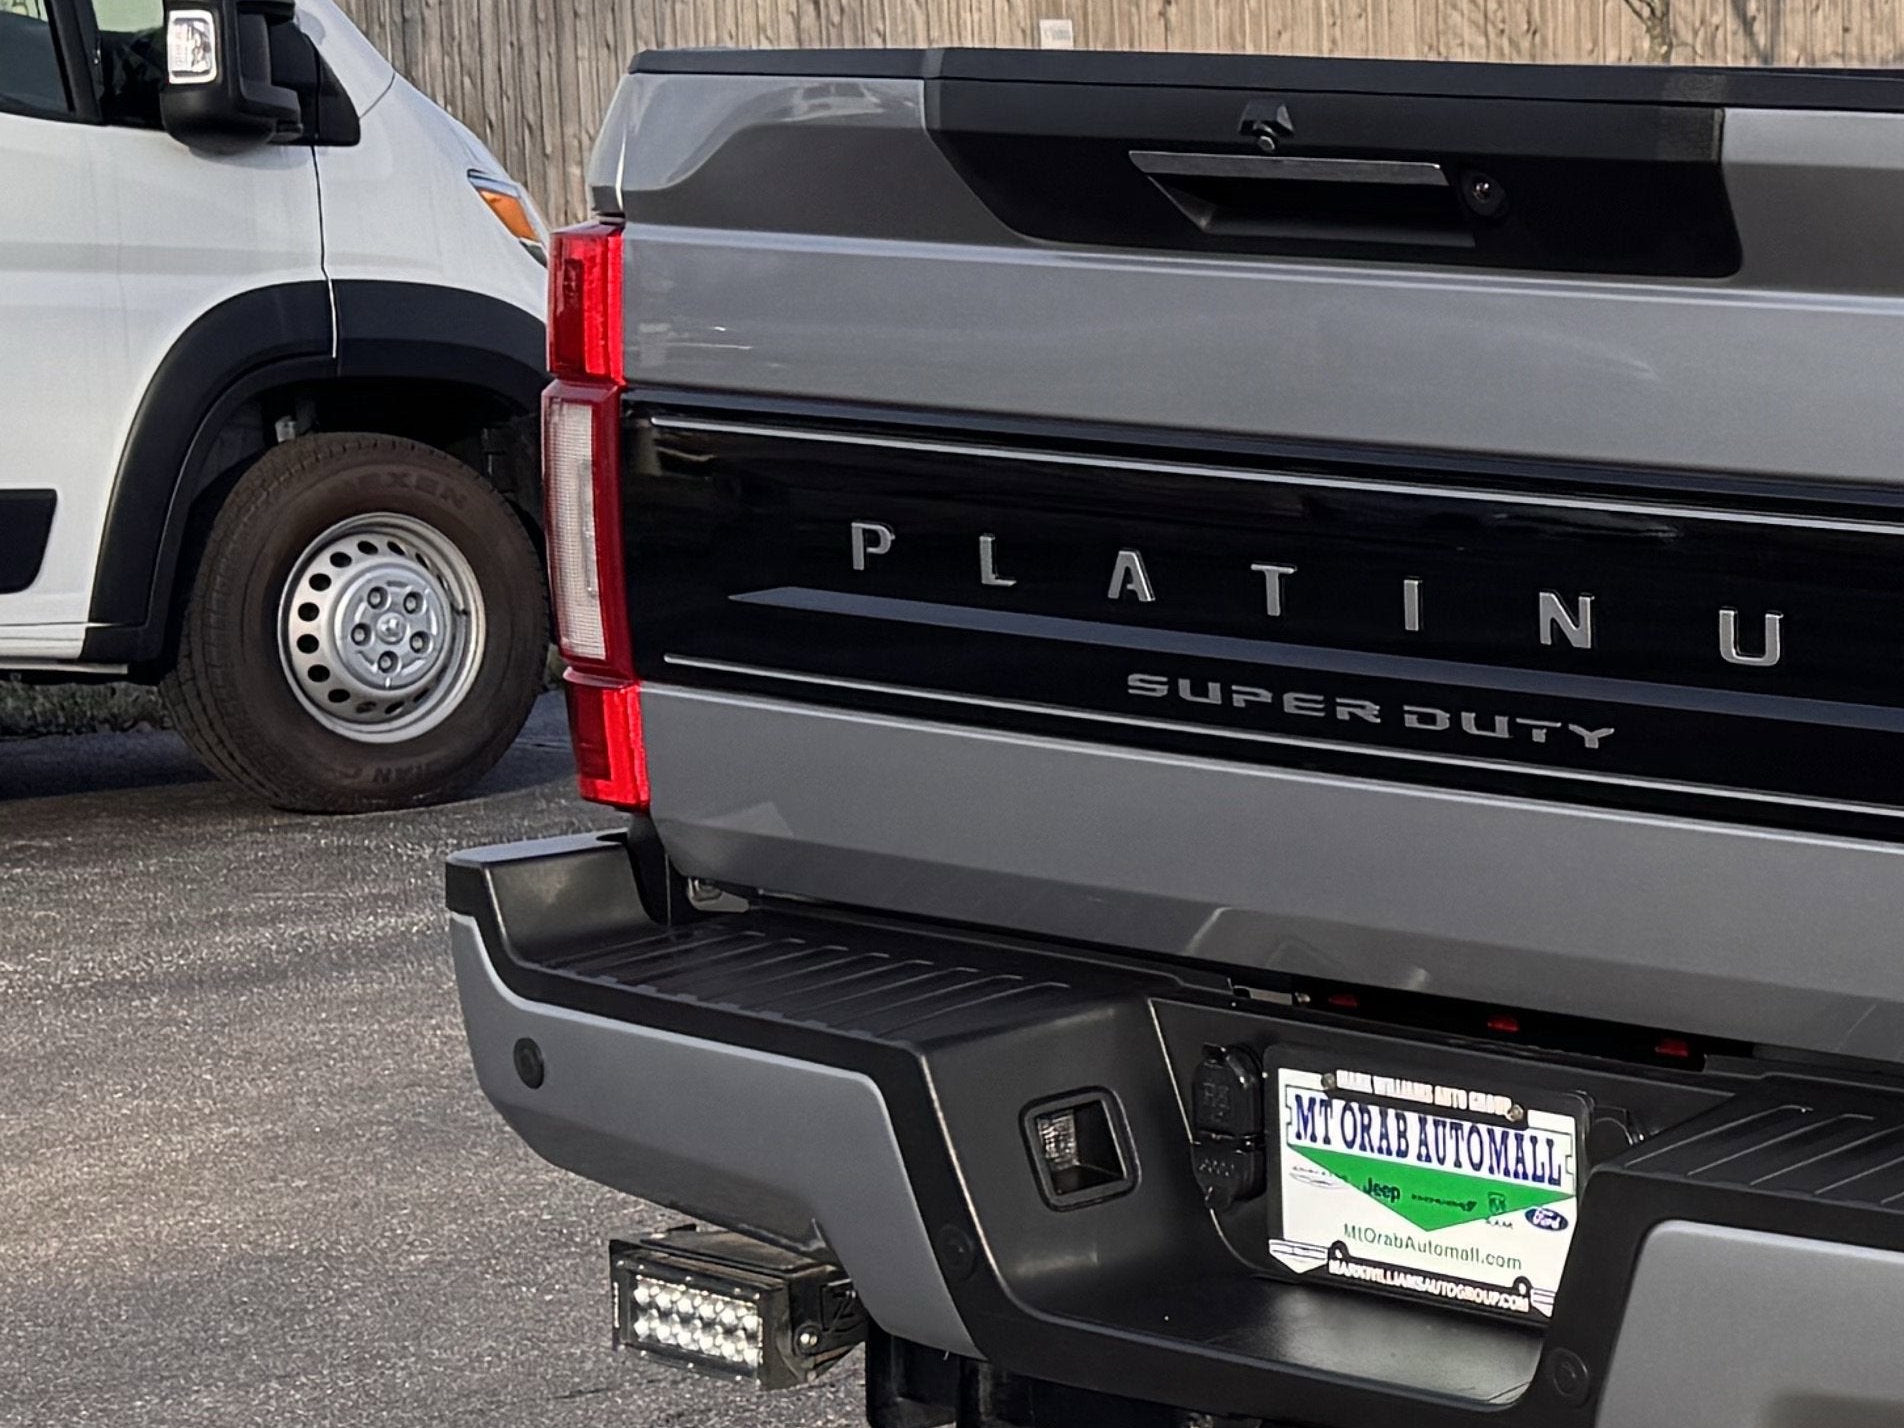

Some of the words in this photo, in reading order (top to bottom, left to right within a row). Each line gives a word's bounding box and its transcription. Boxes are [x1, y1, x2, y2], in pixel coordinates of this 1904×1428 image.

[1125, 670, 1382, 726] SUPER
[1401, 702, 1616, 751] DUTY
[1294, 1093, 1335, 1145] MT
[1340, 1101, 1410, 1160] ORAB
[1415, 1115, 1563, 1187] AUTOMALL
[1363, 1177, 1401, 1204] Jeep
[1531, 1209, 1563, 1230] Ford
[1344, 1223, 1523, 1270] MtOrabAutomall.com
